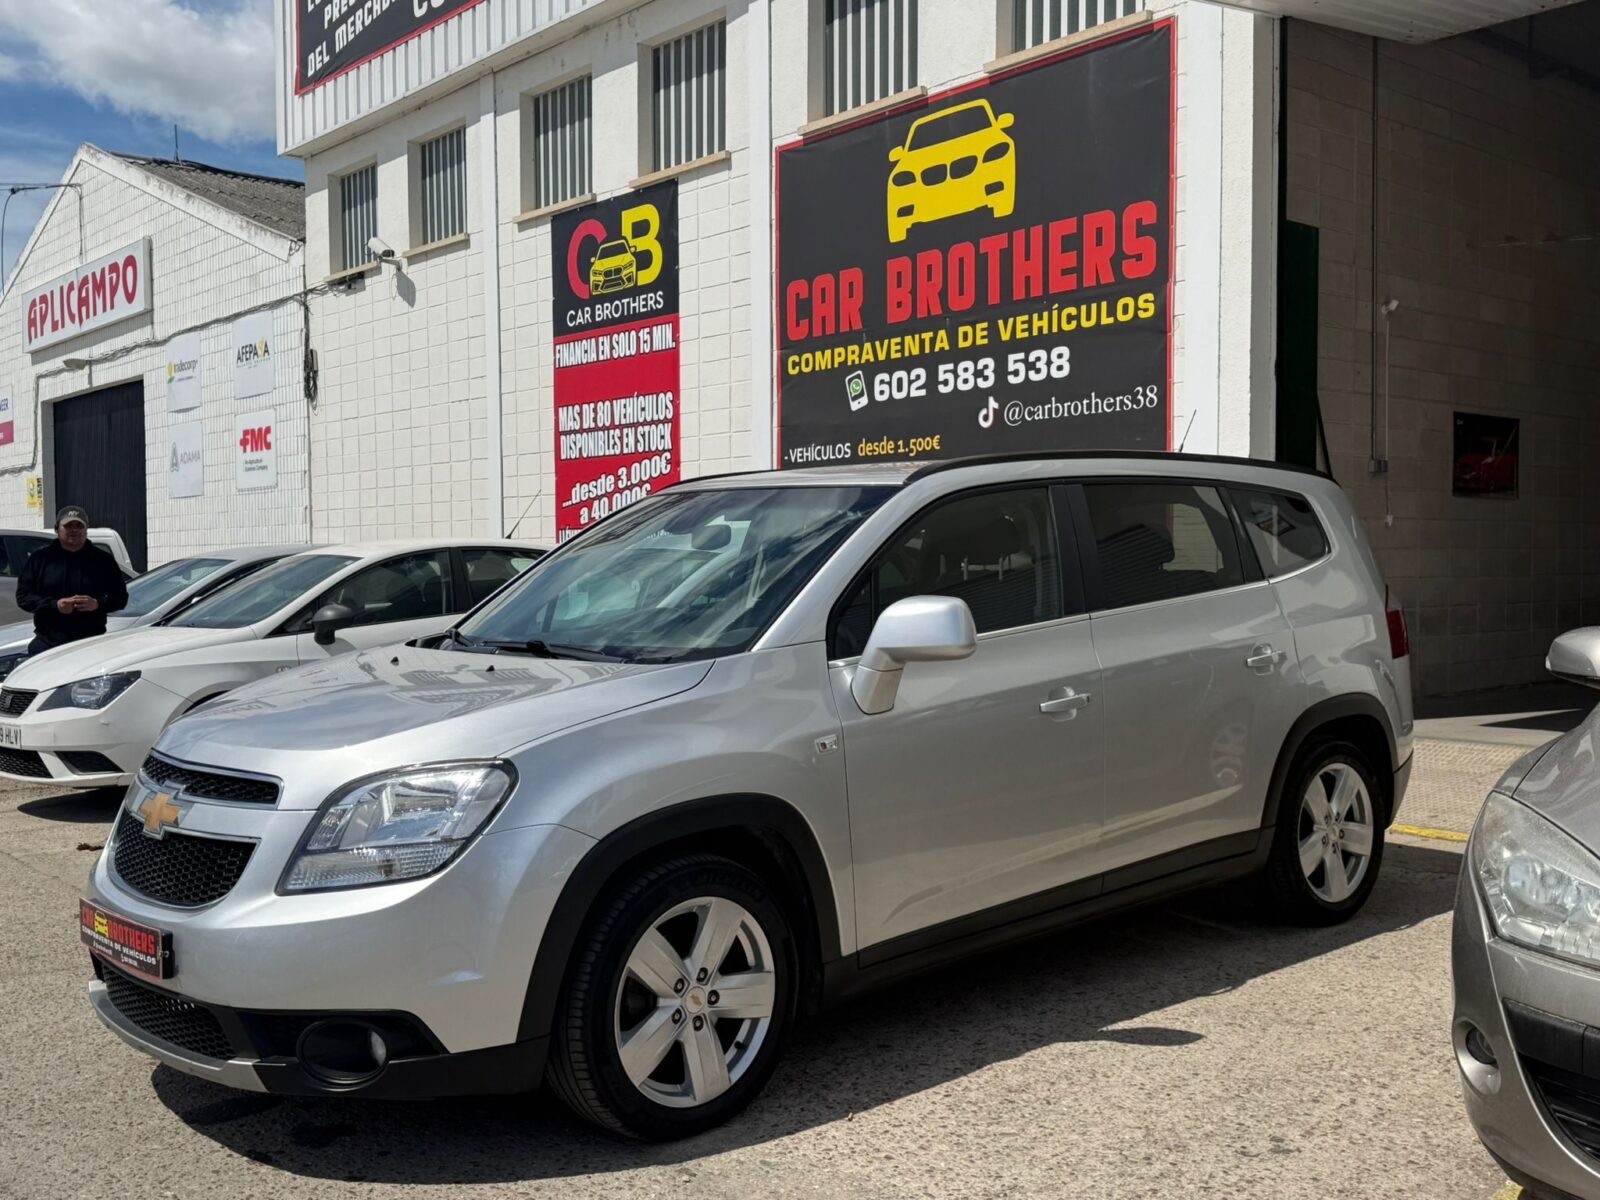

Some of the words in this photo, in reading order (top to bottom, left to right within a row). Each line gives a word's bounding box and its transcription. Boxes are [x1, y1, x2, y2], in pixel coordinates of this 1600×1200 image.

[324, 0, 356, 30] PRE
[307, 41, 330, 78] DEL
[785, 266, 864, 342] CAR
[886, 200, 1158, 324] BROTHERS
[27, 254, 138, 345] APLICAMPO
[566, 307, 592, 327] CAR
[595, 291, 664, 324] BROTHERS
[555, 338, 597, 368] FINANCIA
[598, 335, 610, 360] EN
[612, 330, 637, 359] SOLO
[638, 327, 651, 354] 15
[652, 323, 676, 351] MIN.
[787, 329, 950, 375] COMPRAVENTA
[958, 322, 988, 349] DE
[998, 293, 1155, 342] VEHÍCULOS
[874, 368, 927, 402] 602
[937, 357, 995, 394] 583
[1007, 346, 1070, 384] 538
[559, 405, 580, 432] MAS
[582, 401, 595, 429] DE
[597, 400, 611, 428] 80
[613, 391, 673, 425] VEHÍCULOS
[1004, 385, 1158, 426] @carbrothers38
[240, 426, 272, 453] FMC
[560, 428, 621, 460] DISPONIBLES
[622, 426, 635, 453] EN
[637, 422, 672, 453] STOCK
[858, 436, 894, 456] desde
[897, 435, 941, 457] 1.500€
[617, 452, 671, 489] 3.000€
[580, 507, 589, 525] a
[108, 920, 155, 955] BROTHERS
[122, 945, 157, 965] VEHÍCULOS
